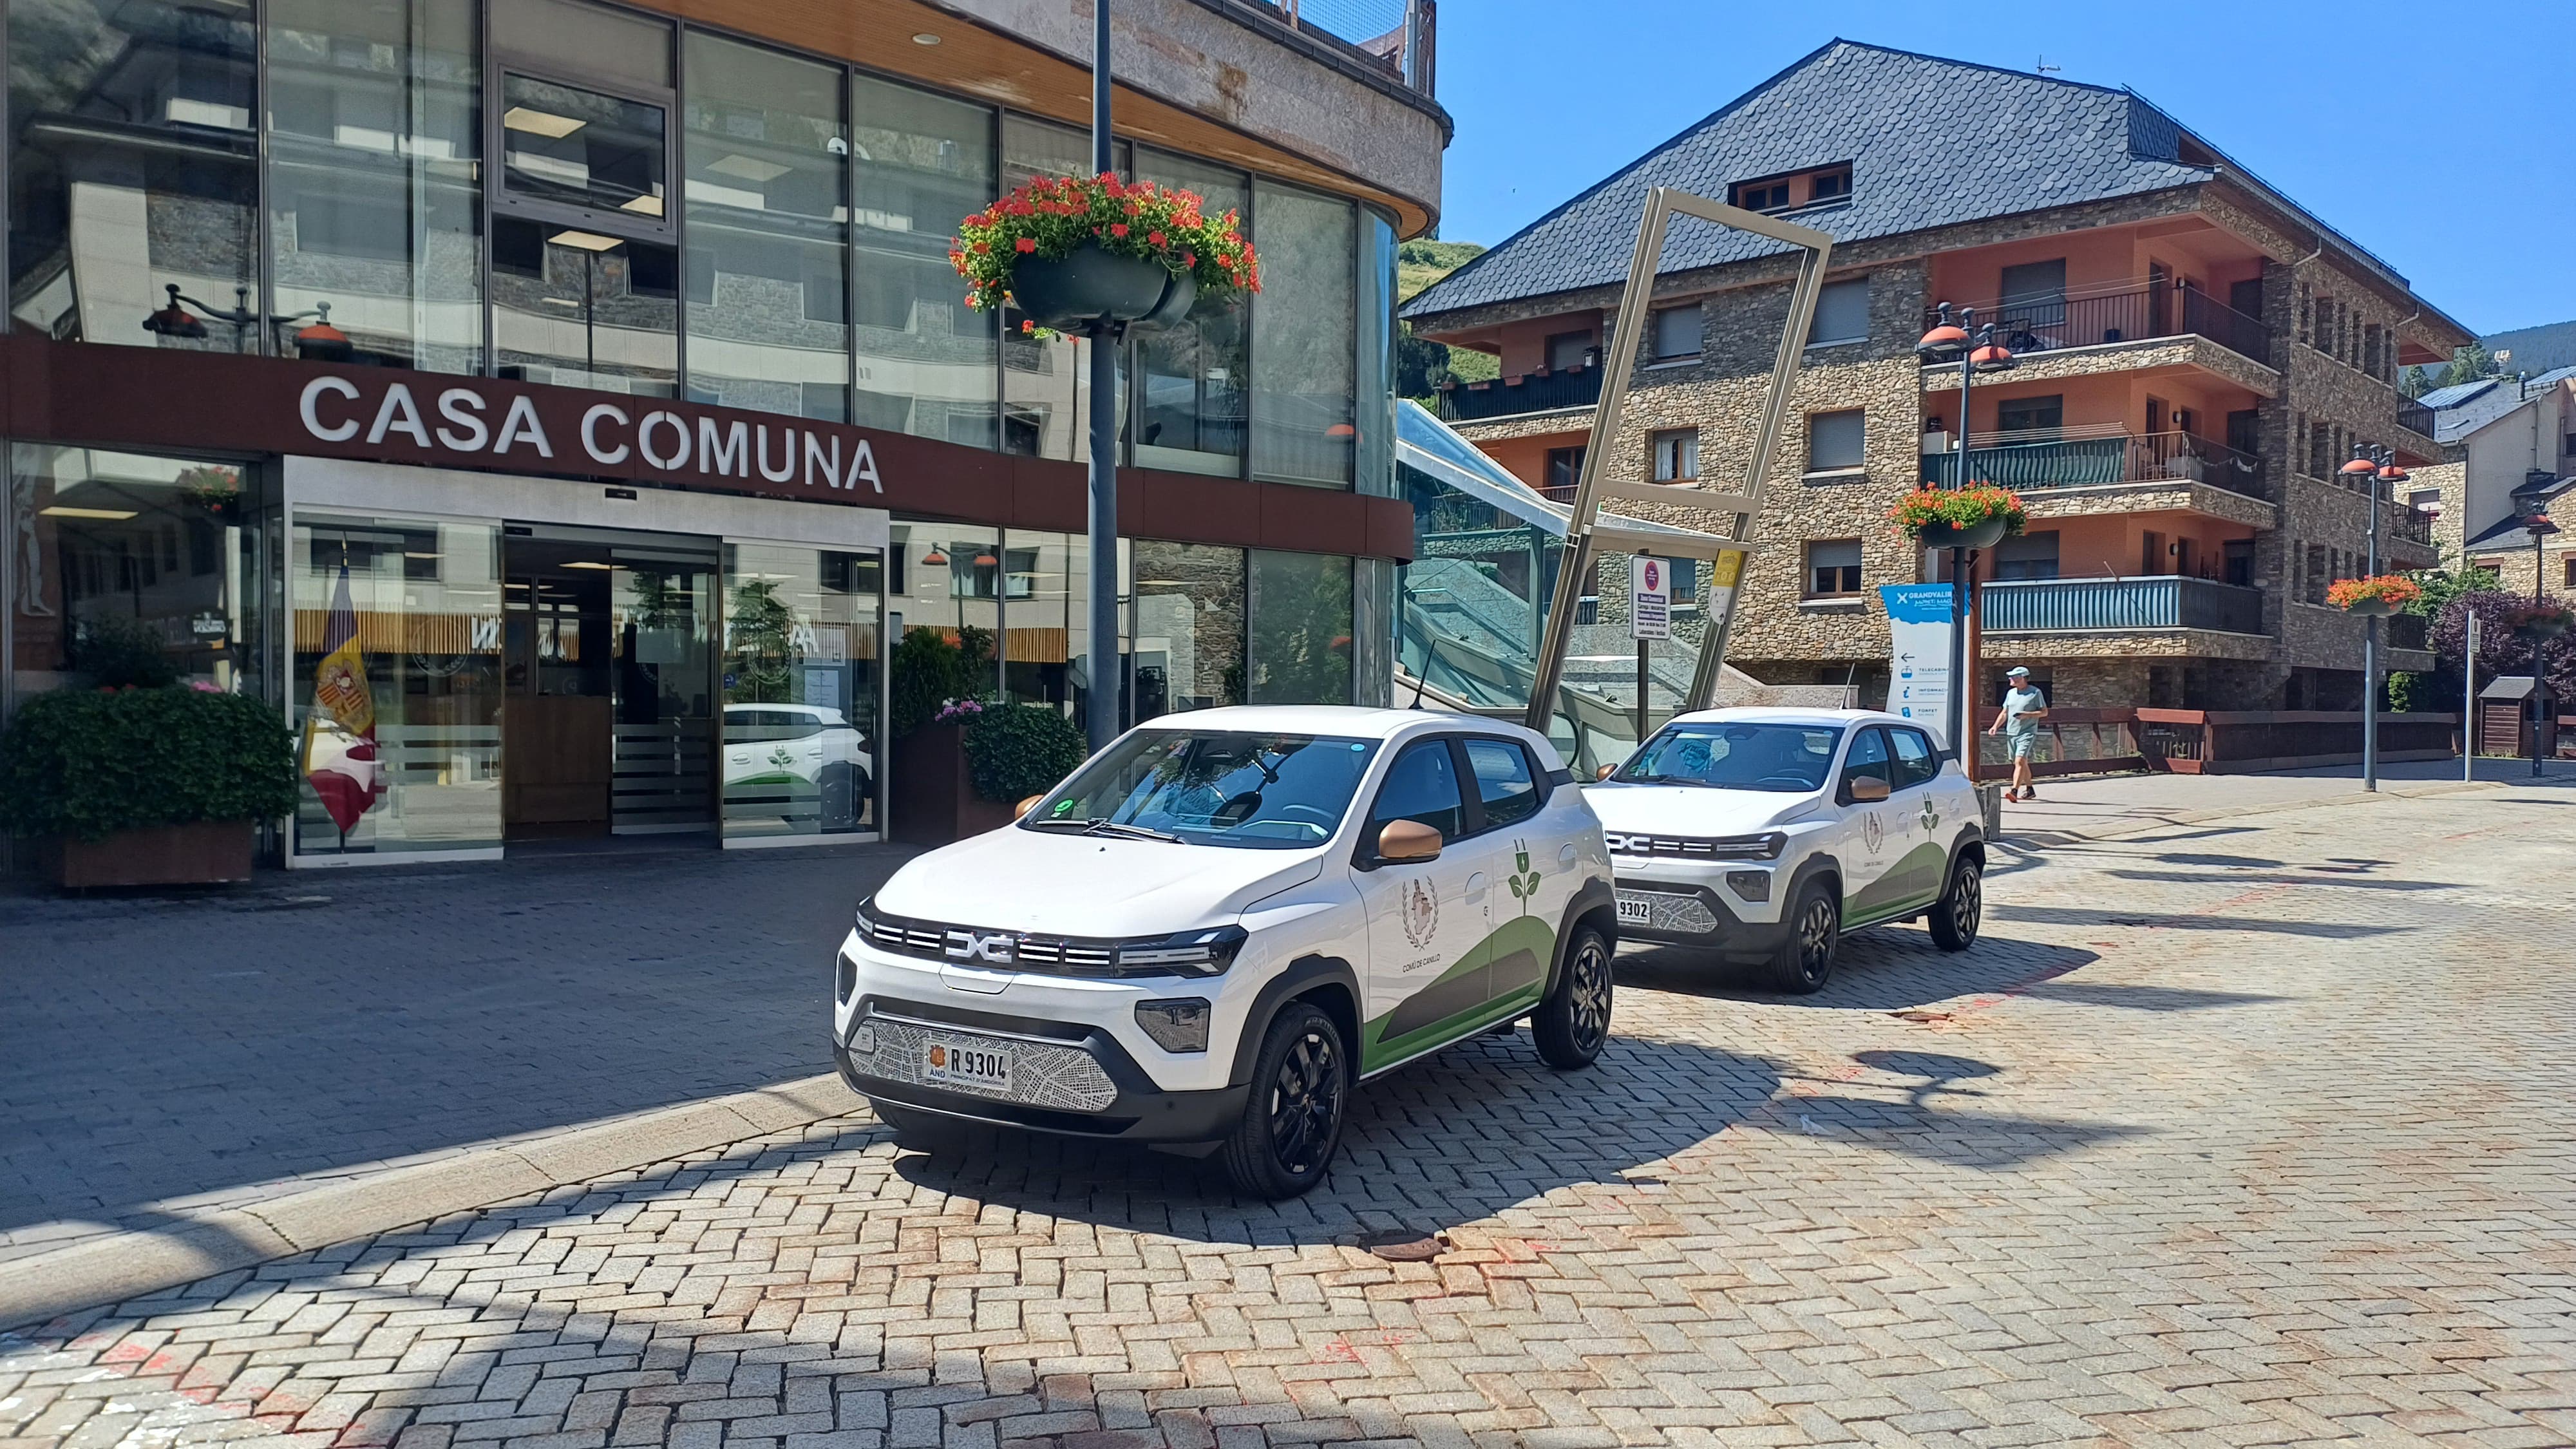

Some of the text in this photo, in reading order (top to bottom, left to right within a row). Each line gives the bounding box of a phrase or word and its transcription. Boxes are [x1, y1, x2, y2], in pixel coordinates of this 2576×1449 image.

[299, 375, 884, 494] CASA COMUNA
[1620, 902, 1647, 917] 9302
[1417, 960, 1423, 968] DE
[951, 1048, 1005, 1079] R 9304
[929, 1069, 945, 1078] AND
